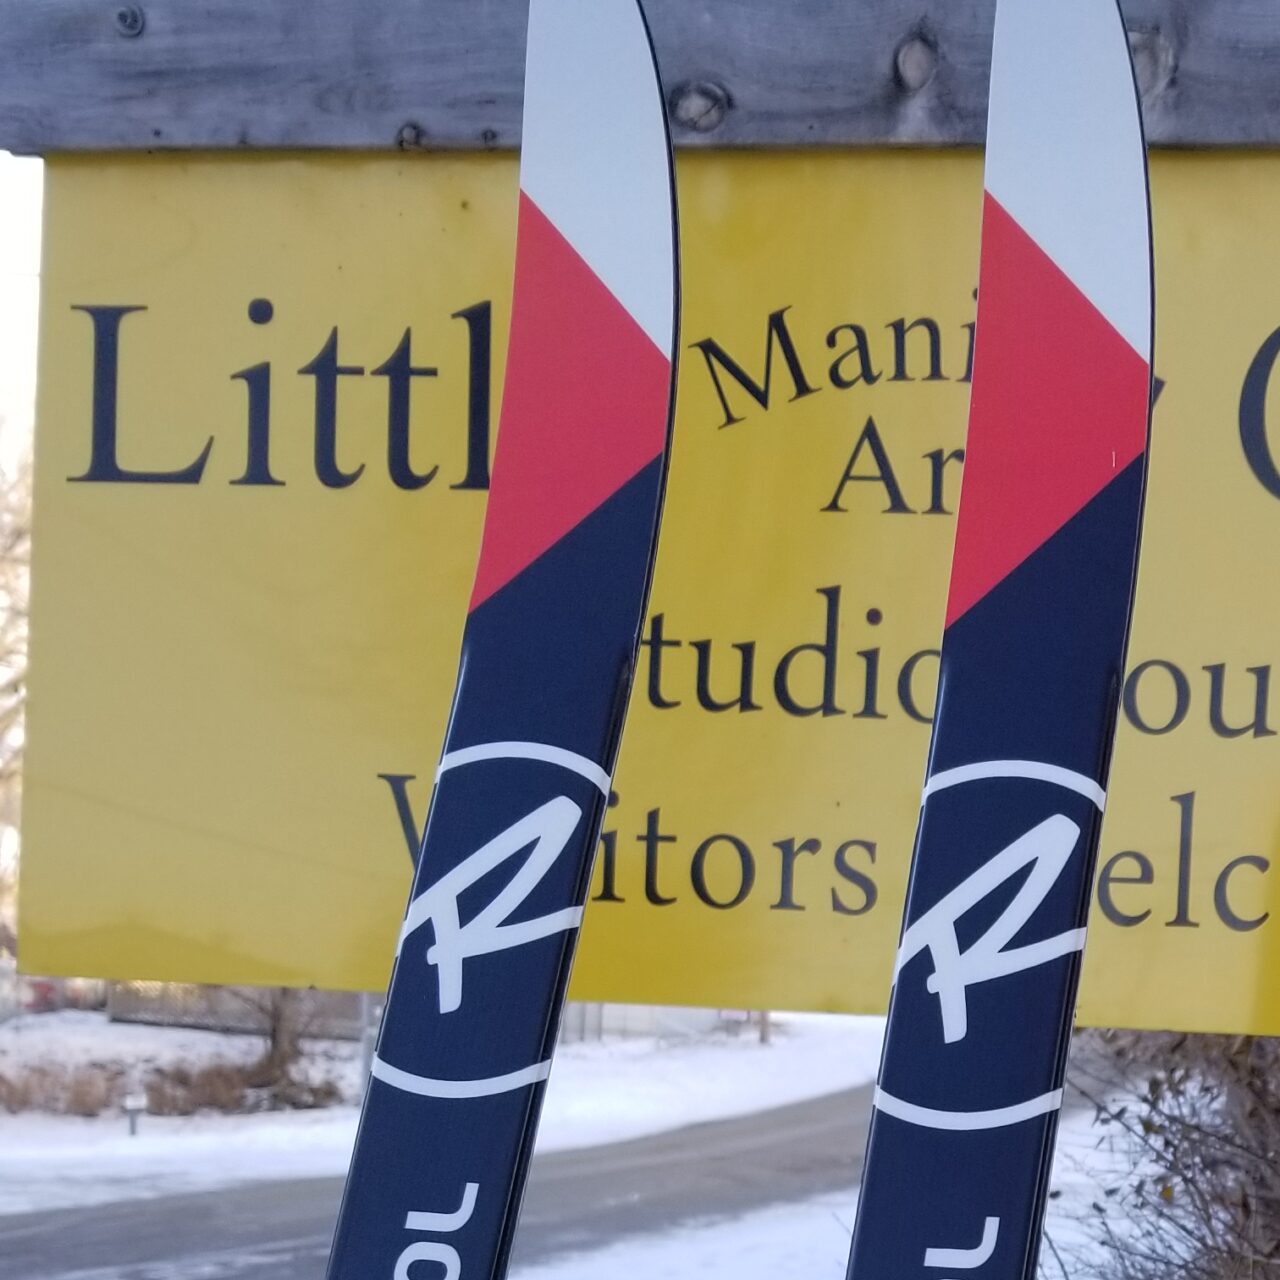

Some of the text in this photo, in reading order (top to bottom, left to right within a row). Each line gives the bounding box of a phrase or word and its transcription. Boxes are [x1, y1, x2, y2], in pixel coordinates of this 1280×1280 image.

[66, 297, 492, 490] Littl
[819, 415, 965, 516] Ar
[640, 584, 941, 725] tudio
[377, 773, 878, 917] itors
